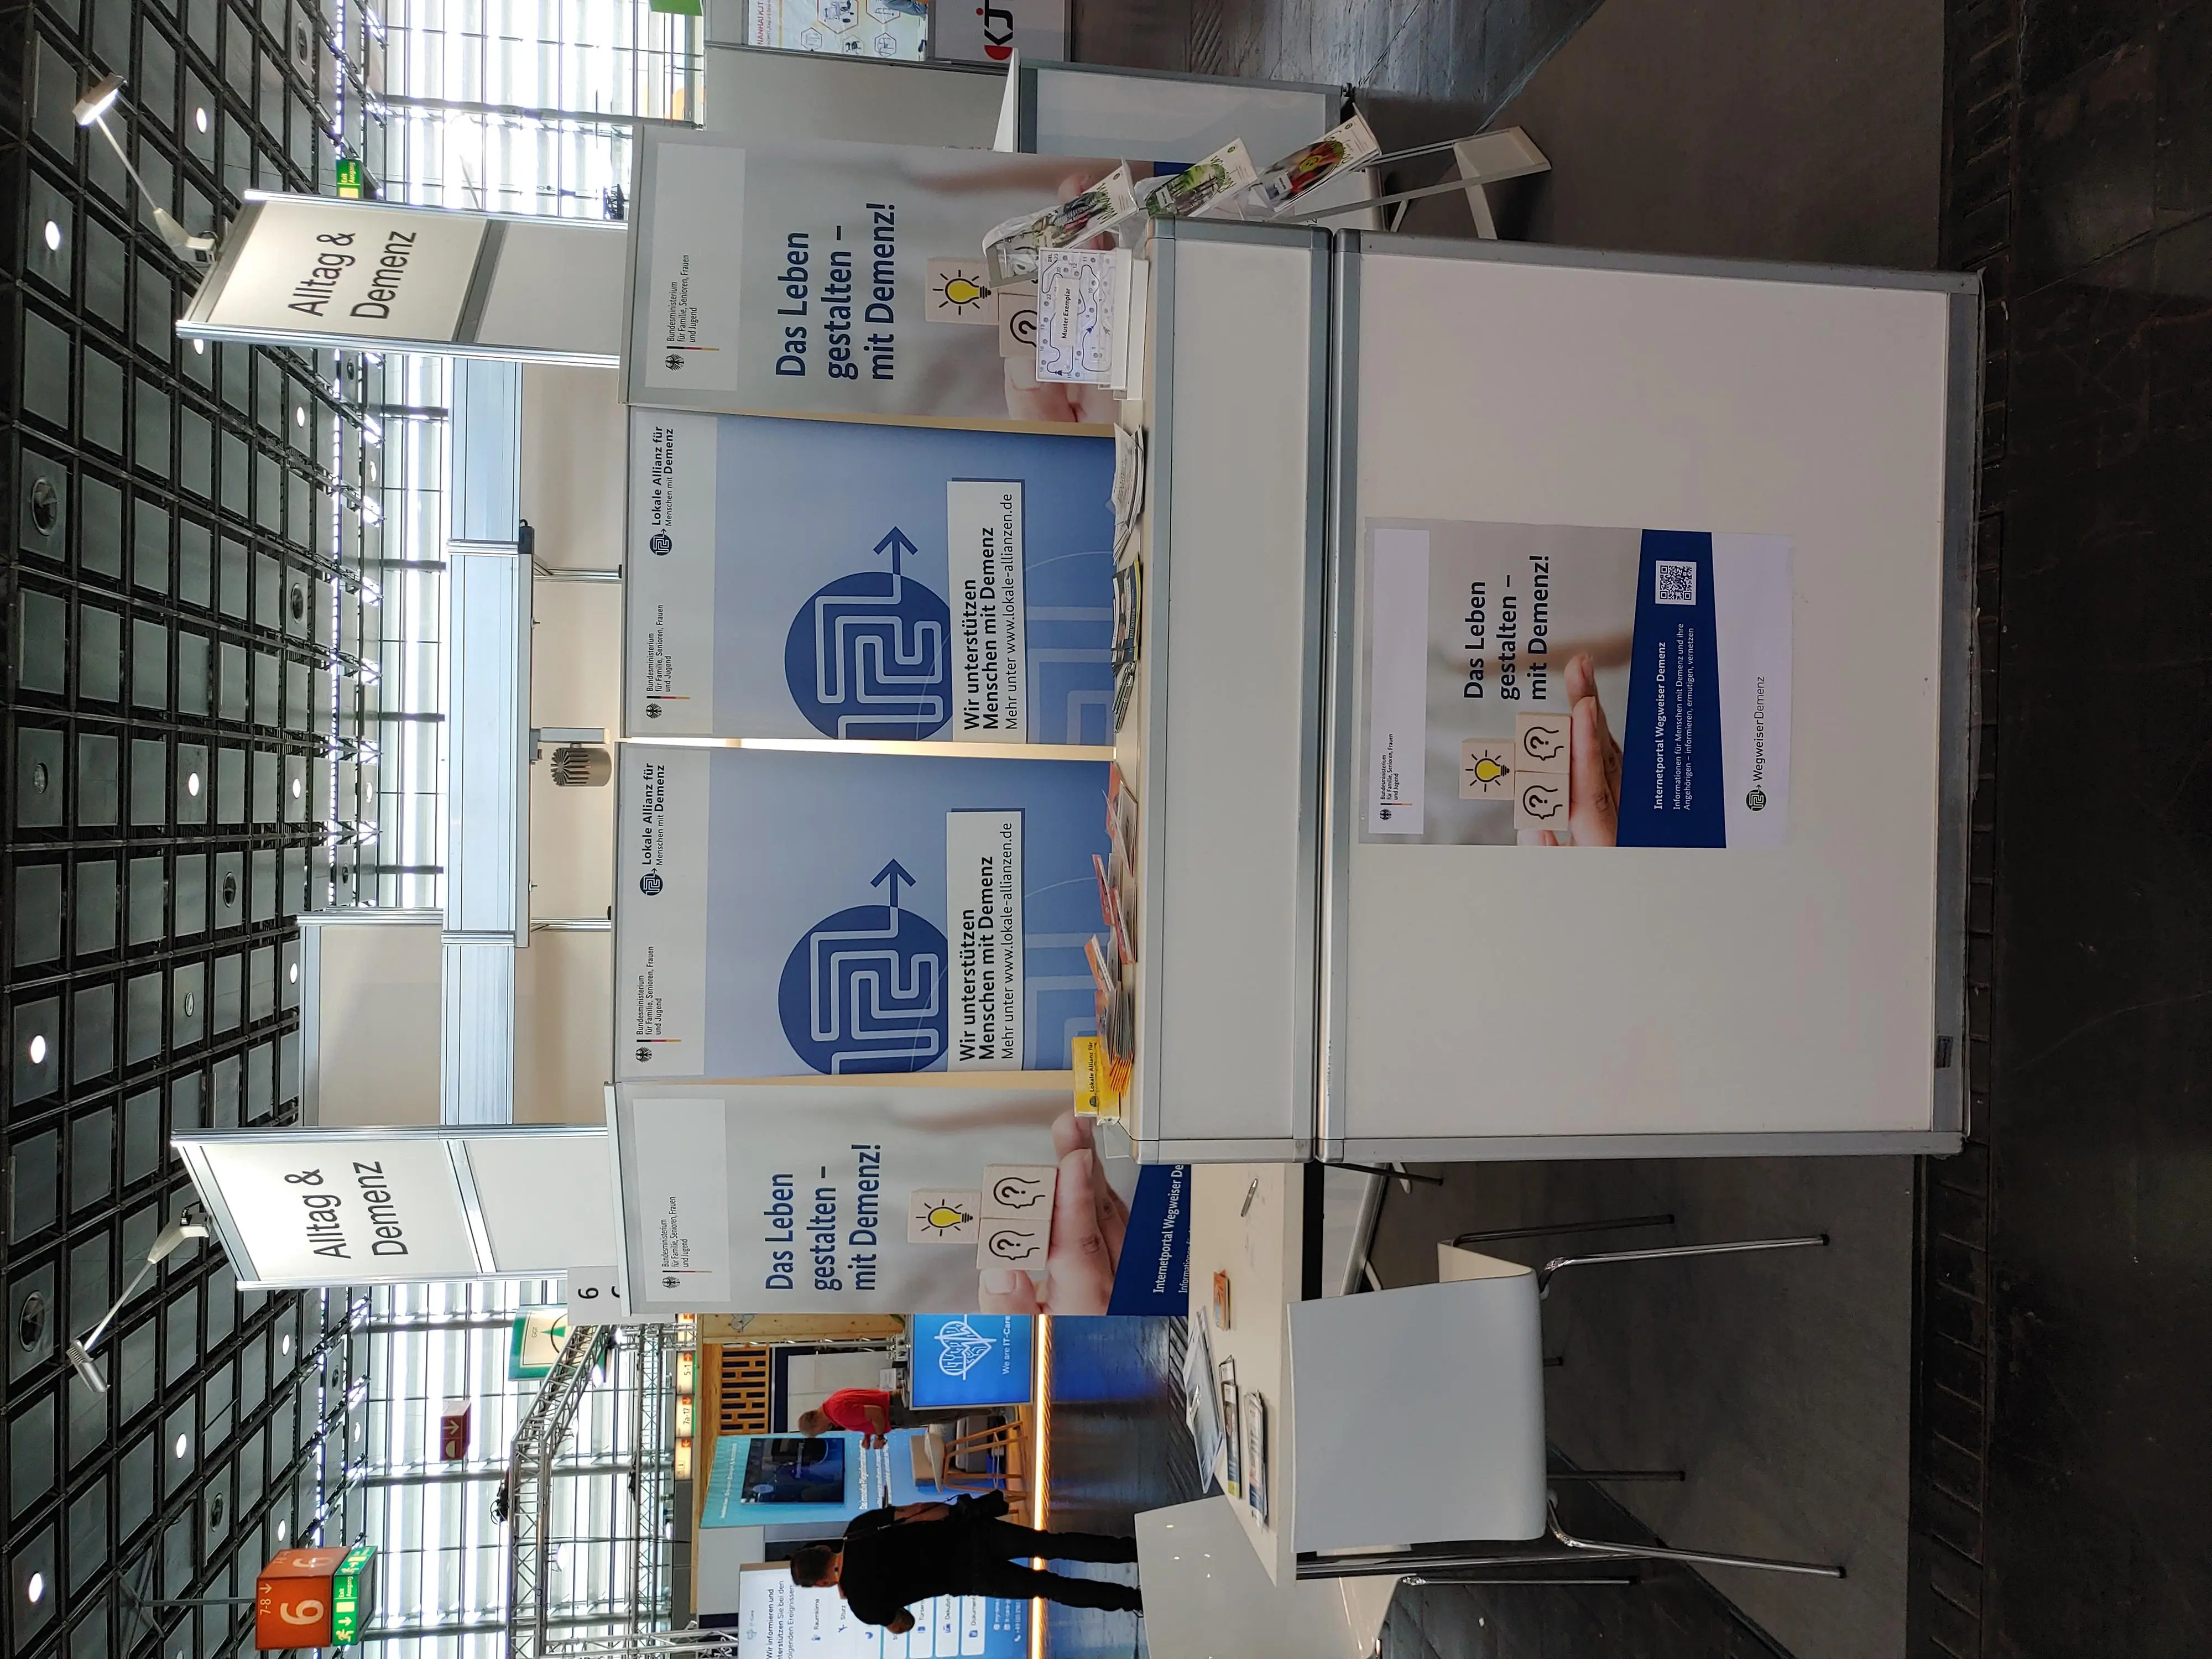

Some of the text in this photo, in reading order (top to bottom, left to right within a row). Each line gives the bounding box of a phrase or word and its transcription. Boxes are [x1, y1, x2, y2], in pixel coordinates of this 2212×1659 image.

[347, 163, 357, 184] Ausgang
[288, 233, 356, 316] Alltag &
[349, 231, 416, 319] Demenz
[679, 278, 689, 306] Senioren,
[680, 255, 689, 275] Frauen
[776, 233, 808, 376] Das Leben
[864, 204, 895, 379] mit Demenz!
[666, 282, 677, 341] Bundesministerium
[678, 308, 687, 331] Familie,
[688, 307, 698, 329] Jugend
[821, 252, 858, 379] gestalten
[651, 427, 662, 525] Lokale Allianz für
[664, 429, 673, 473] Demenz
[980, 528, 998, 729] Menschen mit Demenz
[1000, 494, 1017, 729] Mehr unter www.lokale-allianzen.de
[1464, 582, 1485, 698] Das Leben
[1496, 597, 1520, 700] gestalten
[1527, 556, 1548, 700] mit Demenz!
[1676, 623, 1684, 638] ihre
[664, 656, 672, 679] Jugend
[962, 580, 979, 730] Wir unterstützen
[1654, 643, 1666, 809] Internetportal Wegweiser Demenz
[1674, 743, 1683, 754] für
[1684, 628, 1695, 810] Angehörigen informieren, ermutigen, vernetzen
[1753, 677, 1765, 781] WegweiserDemenz
[642, 763, 653, 864] Lokale Allianz für
[655, 765, 664, 811] Demenz
[978, 857, 994, 1060] Menschen mit Demenz
[1000, 823, 1013, 1058] Mehr unter www.lokale-allianzen.de
[655, 999, 663, 1021] Jugend
[959, 910, 975, 1061] Wir unterstützen
[284, 1169, 351, 1259] Alltag &
[353, 1161, 408, 1255] Demenz
[660, 1220, 670, 1266] Bundesministerium
[669, 1215, 679, 1239] Senioren,
[764, 1175, 793, 1289] Das Leben
[806, 1188, 842, 1291] gestalten
[847, 1145, 880, 1290] mit Demenz!
[1162, 1180, 1181, 1229] Wegweiser
[670, 1240, 679, 1259] Familie,
[680, 1239, 690, 1256] Jugend
[1153, 1231, 1173, 1292] Internetportal
[578, 1288, 598, 1298] 6
[1003, 1361, 1010, 1374] We
[260, 1599, 271, 1615] 7-8
[280, 1600, 324, 1625] 6
